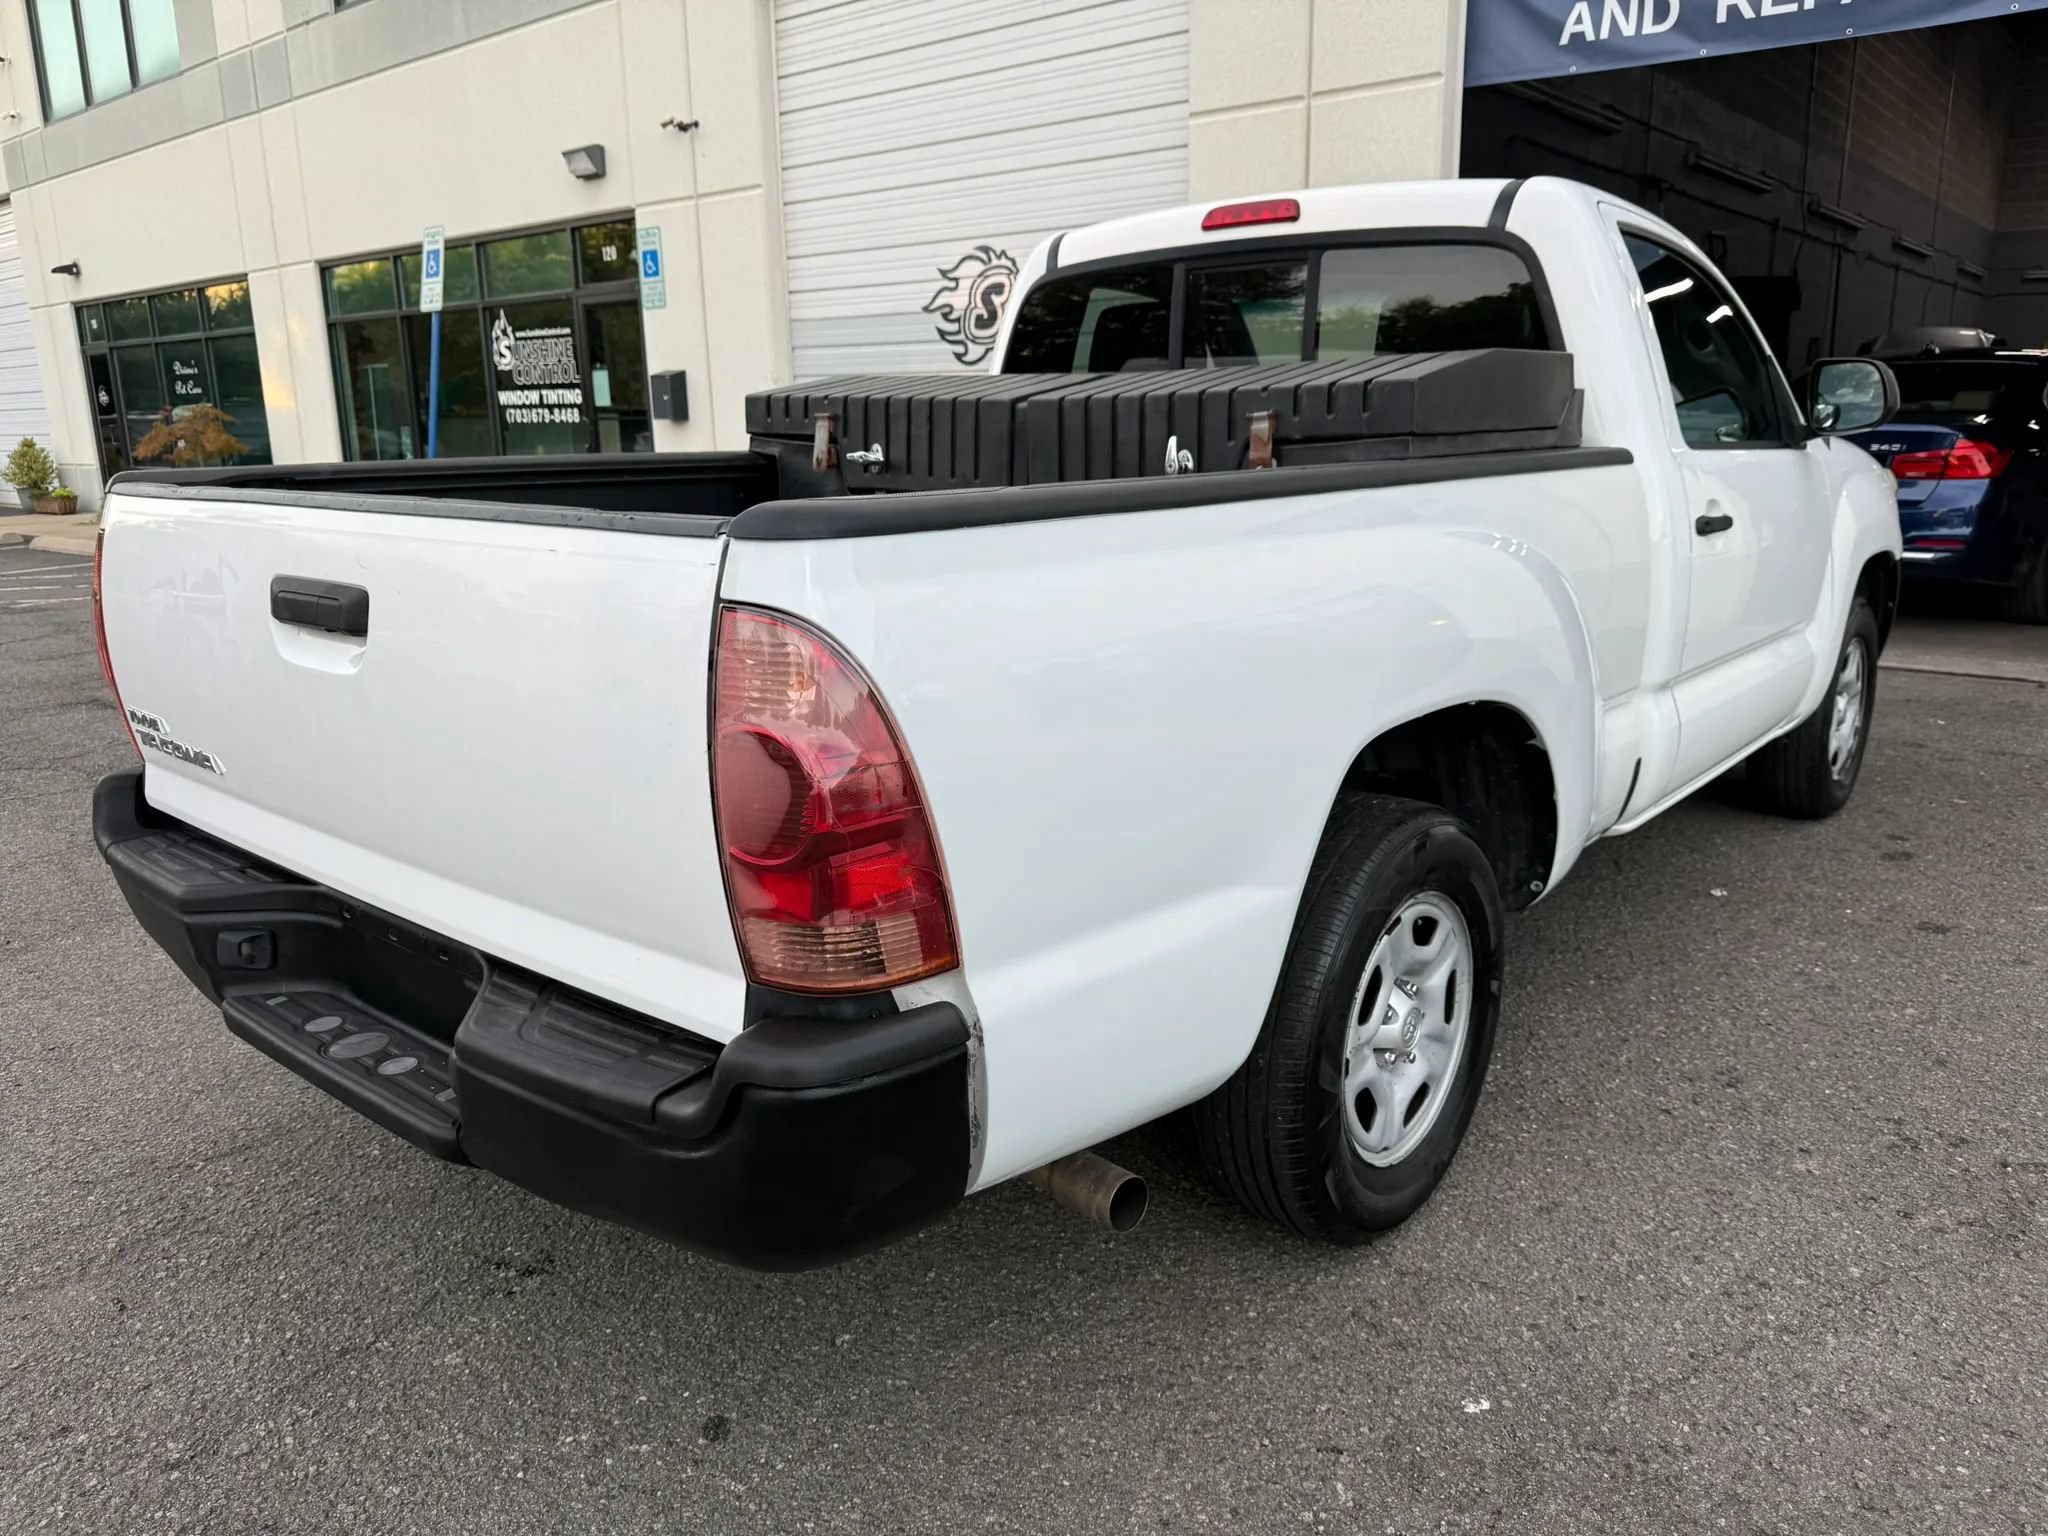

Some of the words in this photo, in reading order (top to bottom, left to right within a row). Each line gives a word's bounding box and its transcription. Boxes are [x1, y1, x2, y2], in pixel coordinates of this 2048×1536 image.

[1558, 0, 1680, 46] AND
[601, 245, 617, 262] 120
[512, 360, 581, 386] CONTROL
[498, 389, 540, 406] WINDOW
[541, 388, 583, 405] TINTING
